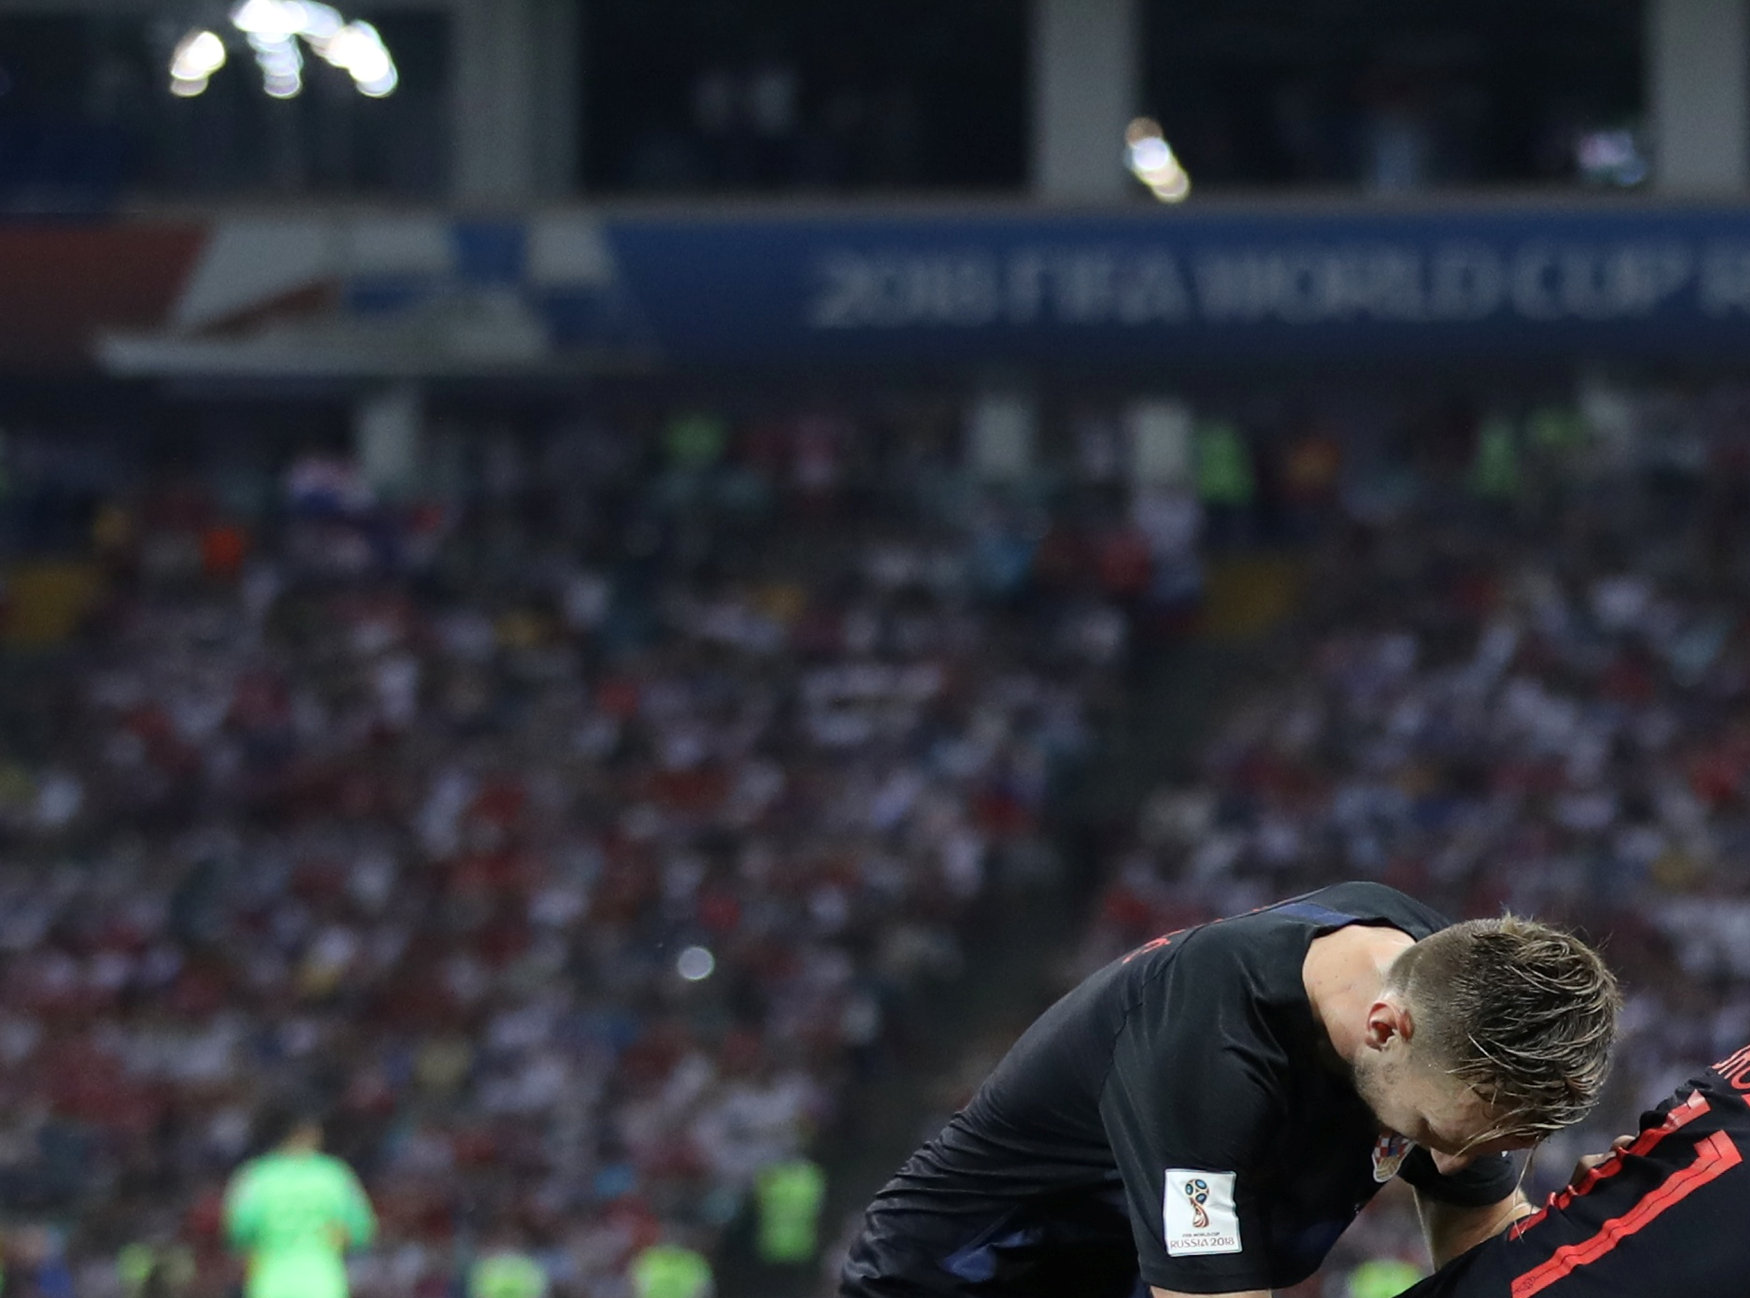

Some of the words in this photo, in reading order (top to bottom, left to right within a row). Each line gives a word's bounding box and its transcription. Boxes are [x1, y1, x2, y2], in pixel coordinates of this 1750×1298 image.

[1006, 242, 1193, 326] FIFA
[1199, 240, 1498, 323] WORLD
[1510, 238, 1697, 321] CUP
[1170, 1238, 1209, 1249] RUSSIA
[1210, 1236, 1235, 1247] 2018
